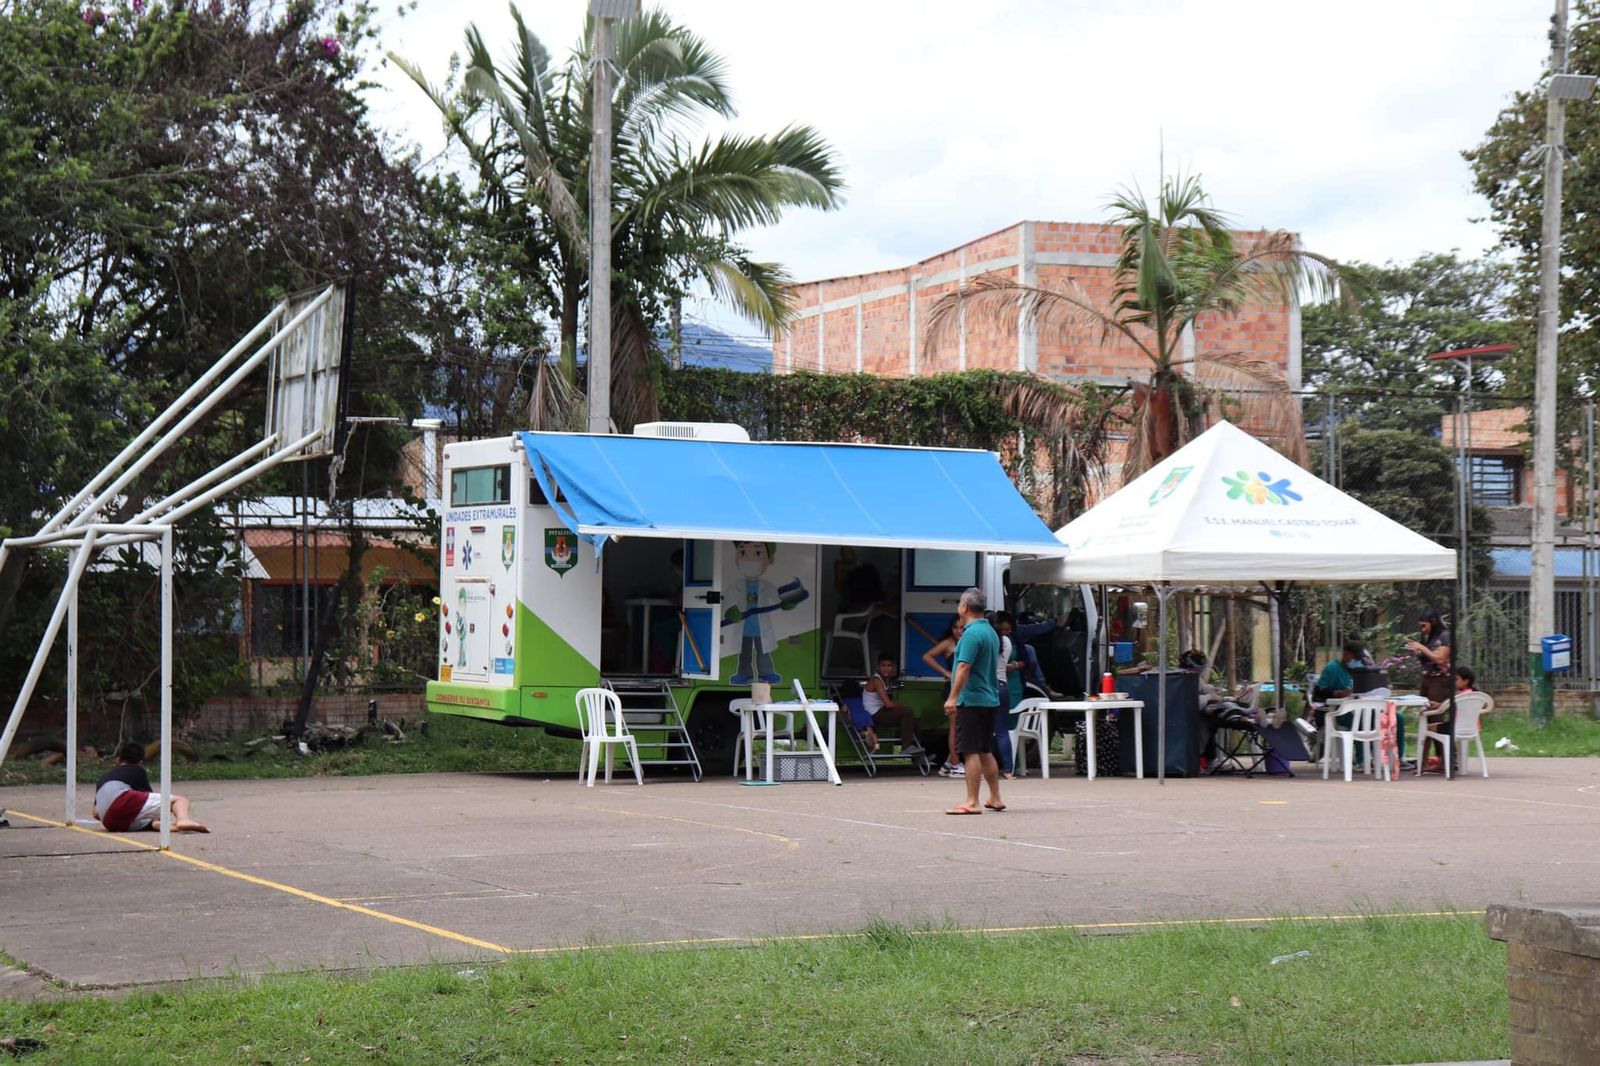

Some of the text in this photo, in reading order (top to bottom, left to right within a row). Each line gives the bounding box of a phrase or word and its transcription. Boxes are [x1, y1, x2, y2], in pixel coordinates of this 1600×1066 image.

[446, 507, 517, 522] UNIDADES EXTRAMURALES
[1230, 518, 1275, 526] MANUEL
[1277, 518, 1320, 527] CASTRO
